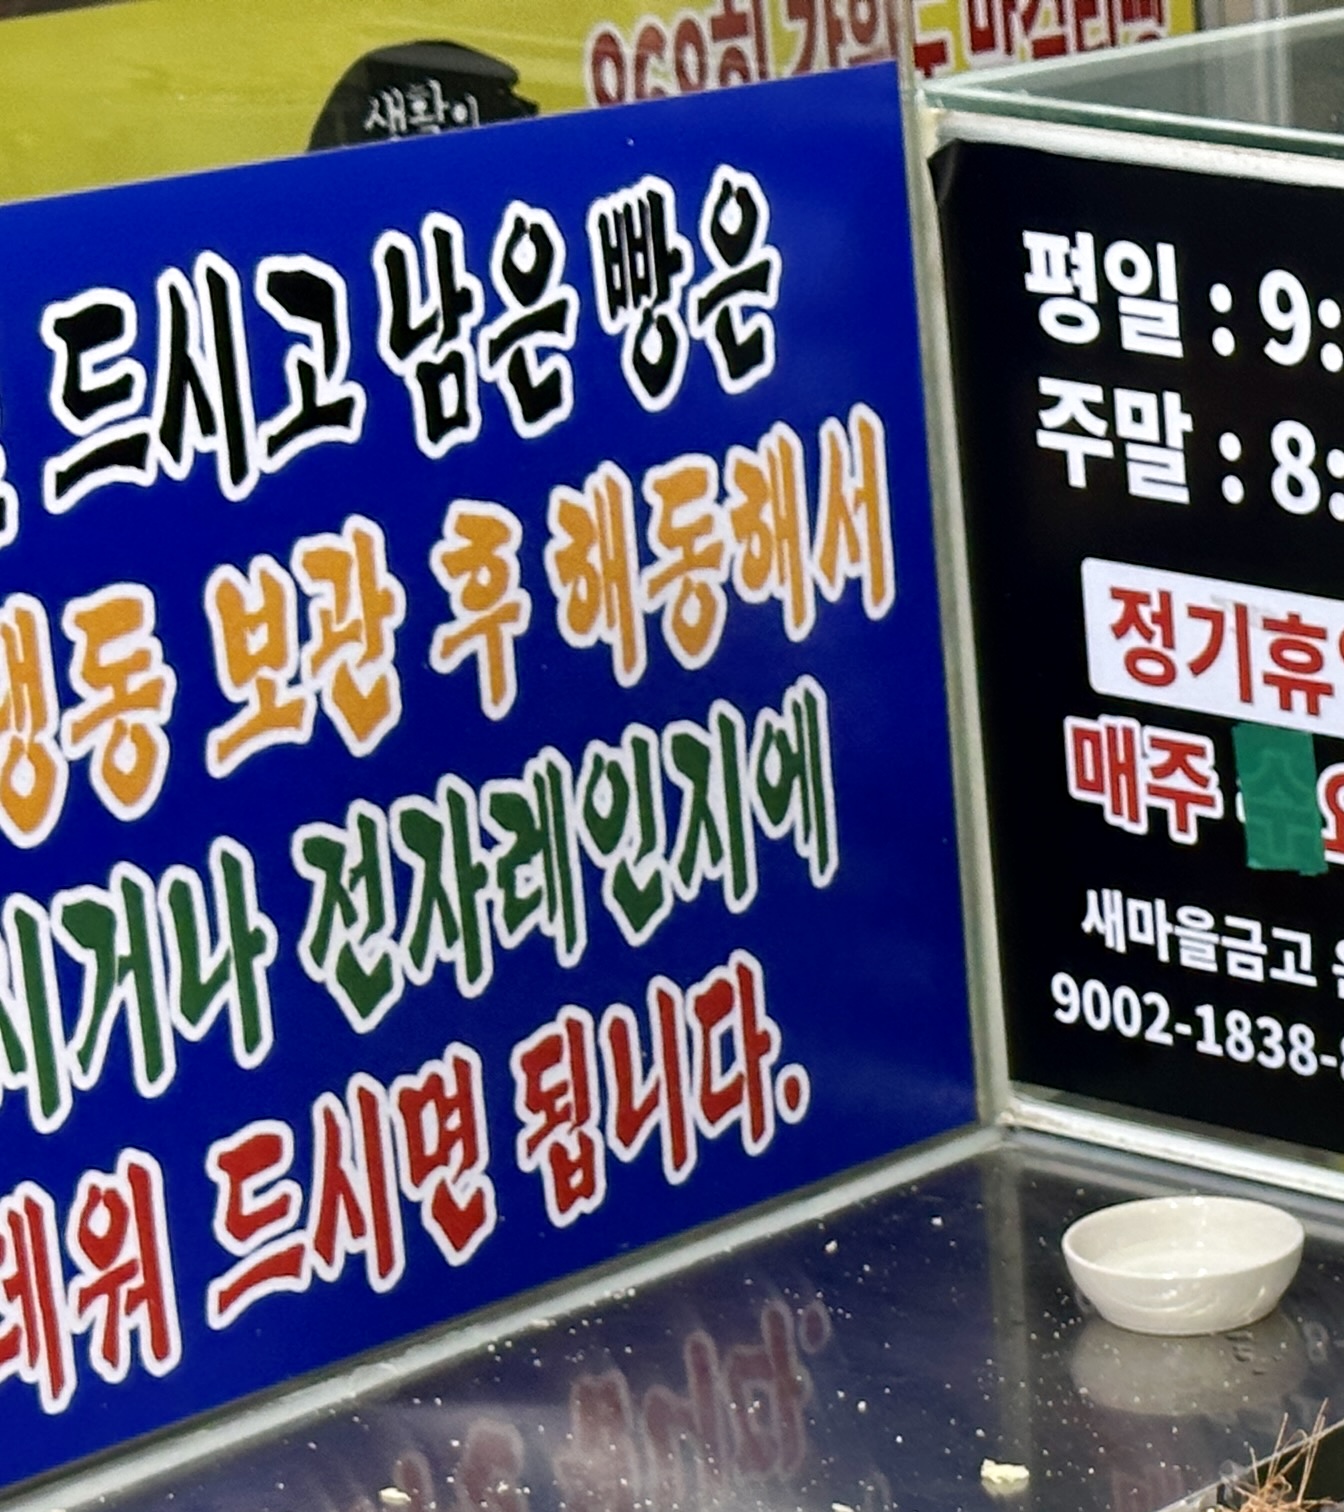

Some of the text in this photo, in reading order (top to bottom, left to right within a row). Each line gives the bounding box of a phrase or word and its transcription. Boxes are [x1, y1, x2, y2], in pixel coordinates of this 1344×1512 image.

[43, 252, 366, 514] 드시고
[375, 201, 578, 458] 남은
[591, 165, 781, 411] 빵은
[1022, 230, 1184, 359] 평일
[1036, 376, 1194, 504] 주말
[205, 515, 405, 779] 보관
[431, 500, 531, 720] 후
[547, 402, 896, 688] 해동해서
[293, 676, 839, 1033] 전자레인지에
[1064, 714, 1224, 846] 매주
[1081, 887, 1319, 989] 새마을금고
[207, 1043, 497, 1330] 드시면
[511, 950, 811, 1227] 됩니다.
